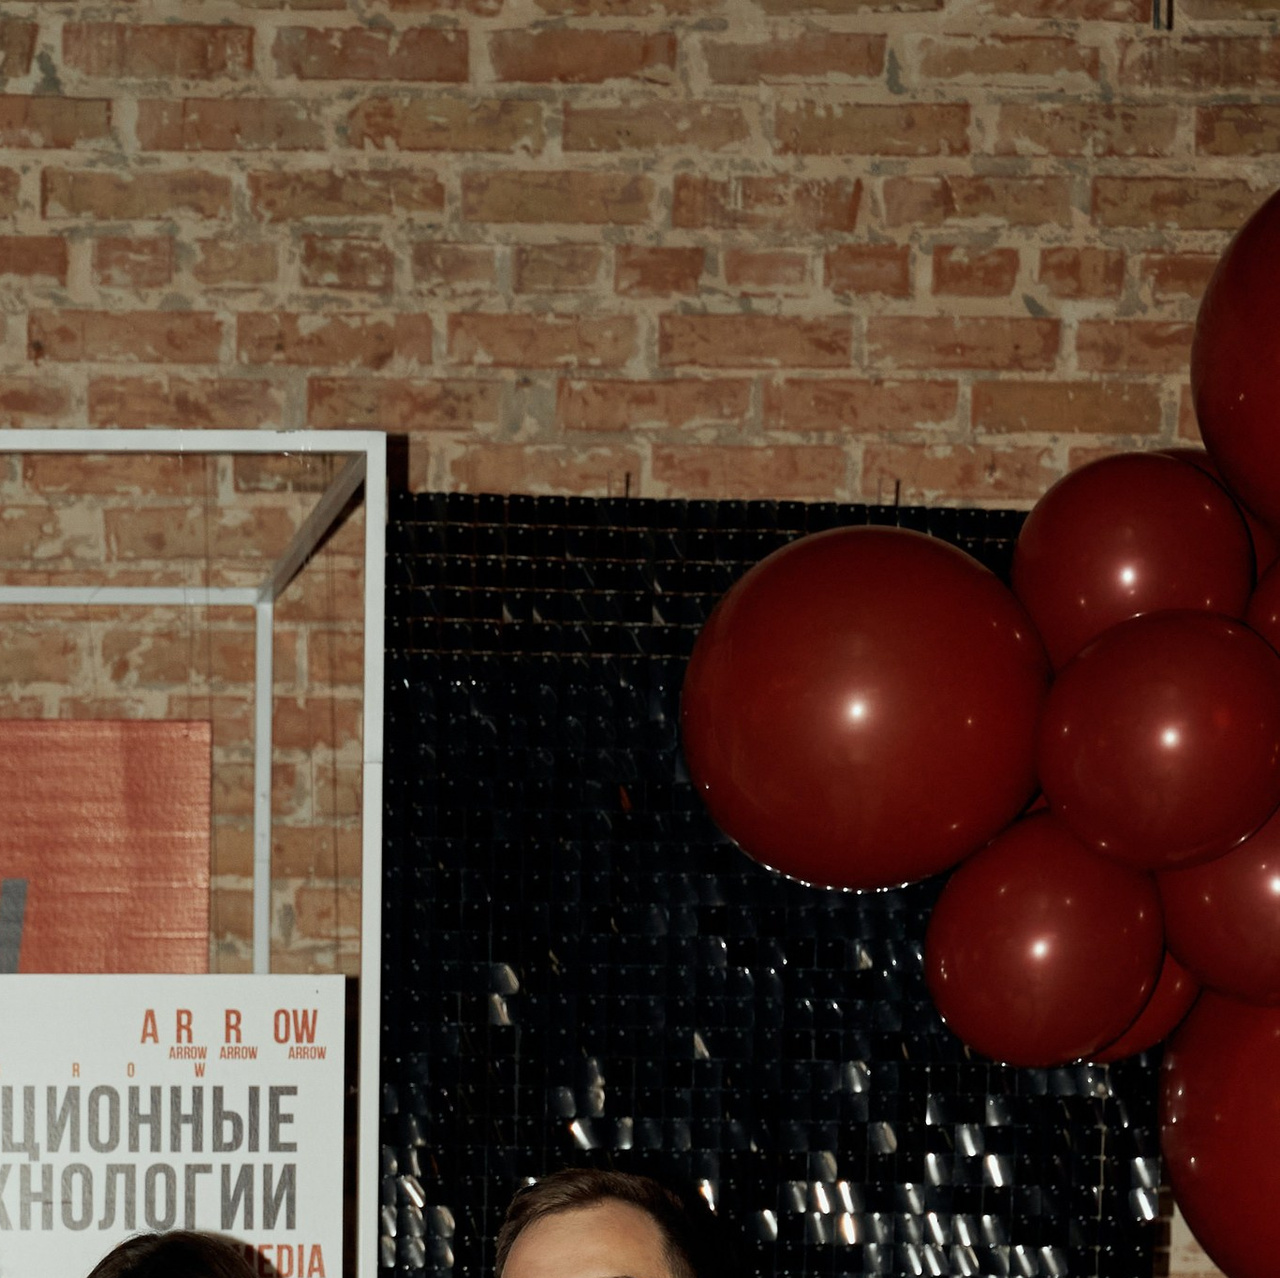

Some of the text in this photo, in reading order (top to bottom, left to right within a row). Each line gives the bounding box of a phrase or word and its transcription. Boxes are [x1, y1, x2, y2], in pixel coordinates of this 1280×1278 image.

[169, 1046, 326, 1060] ARROW ARROW ARROW
